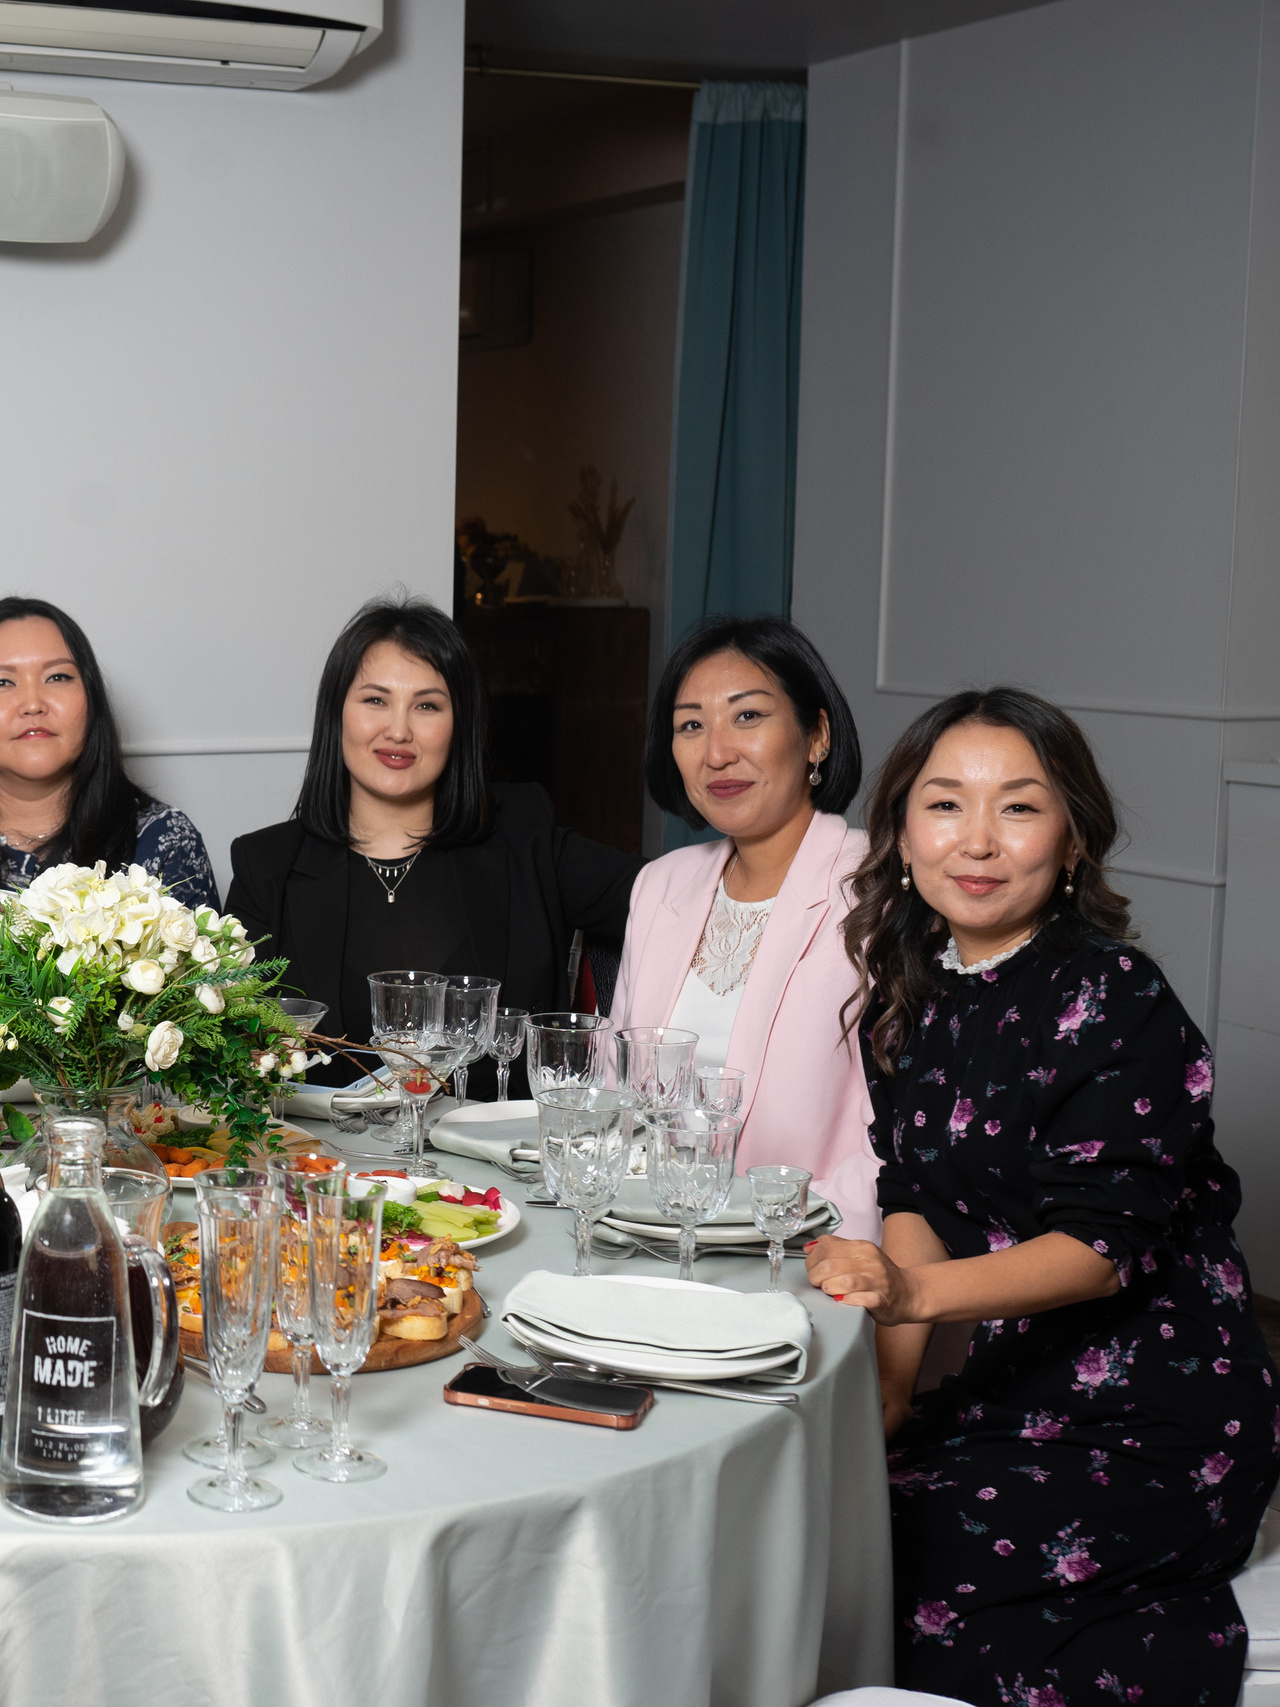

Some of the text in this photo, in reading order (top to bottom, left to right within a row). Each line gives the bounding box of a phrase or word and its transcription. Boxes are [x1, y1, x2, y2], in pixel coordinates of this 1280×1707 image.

[45, 1335, 92, 1357] HOME
[34, 1355, 97, 1388] MADE
[36, 1405, 86, 1426] 1 LITRE
